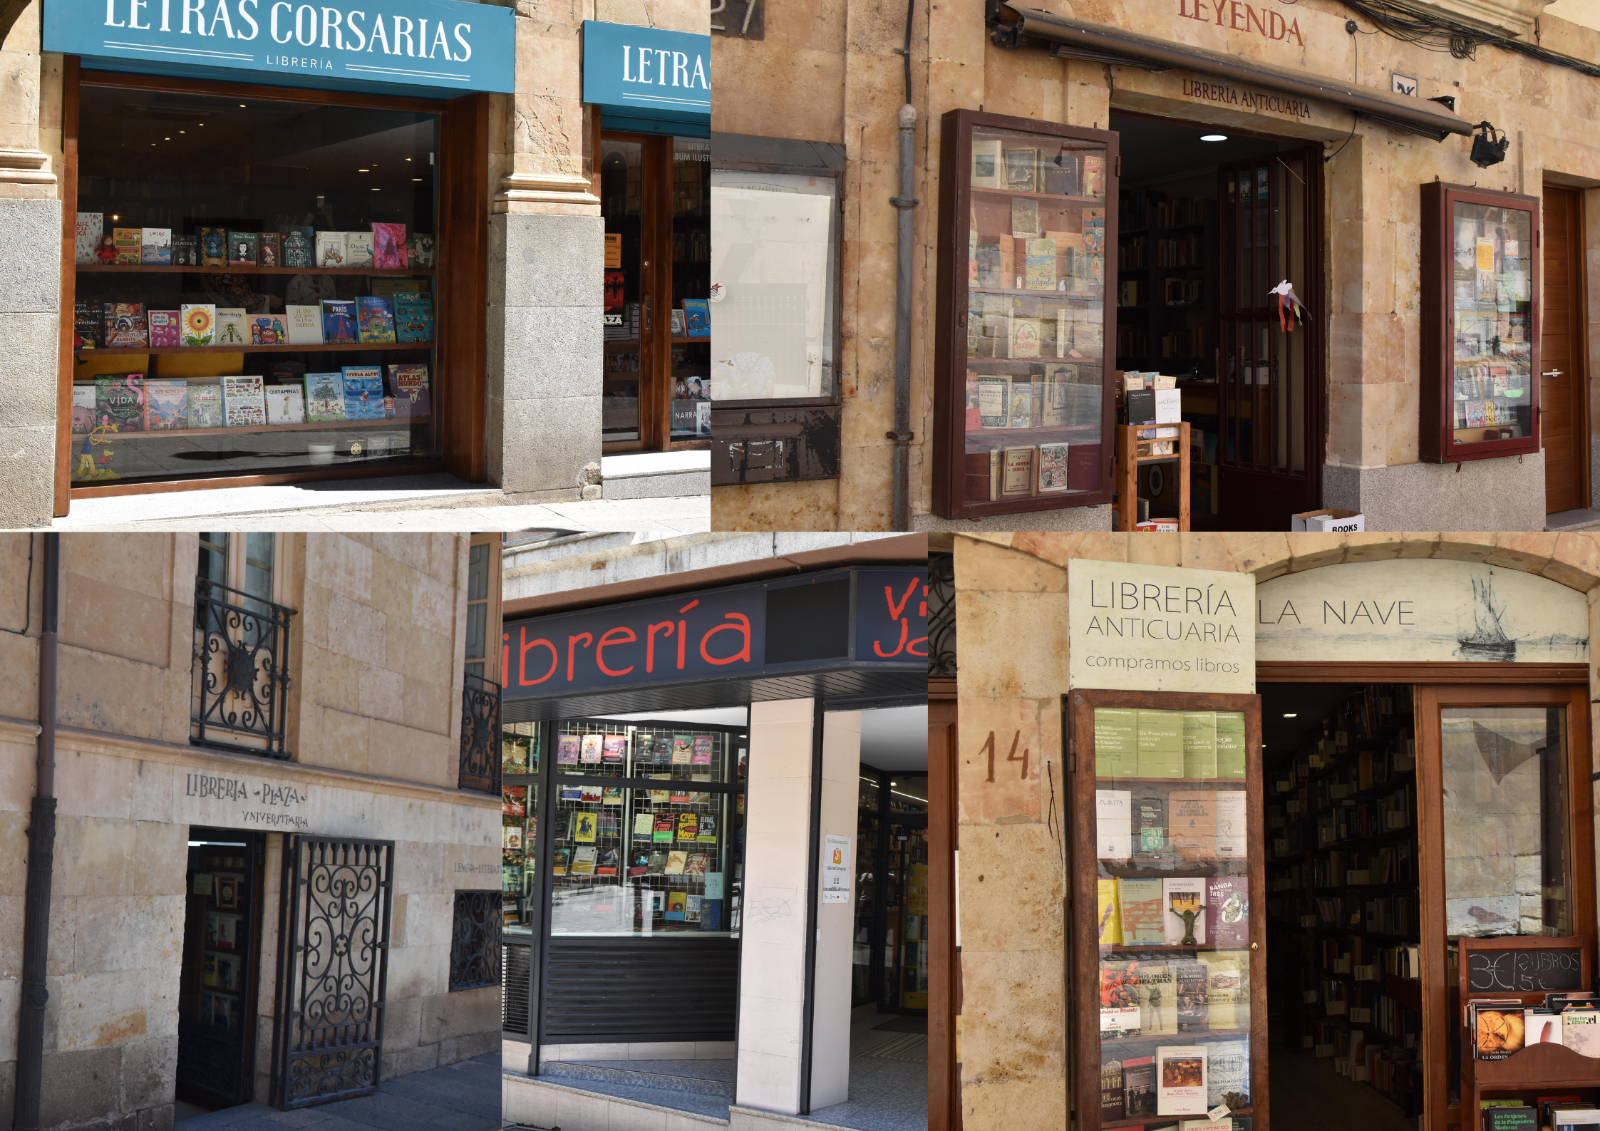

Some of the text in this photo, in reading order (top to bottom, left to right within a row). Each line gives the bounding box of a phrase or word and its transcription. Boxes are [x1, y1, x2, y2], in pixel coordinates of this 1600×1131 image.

[104, 0, 472, 62] LETRAS CORSARIAS
[1178, 0, 1304, 47] LEYENDA
[266, 54, 333, 70] LIBRERÍA
[623, 45, 711, 90] LETRA
[1183, 78, 1311, 119] LIBRERÍA ANTICUARIA
[673, 154, 691, 162] BUM
[109, 396, 134, 406] VIDA
[675, 412, 697, 420] NARRA
[1333, 524, 1358, 532] BOOKS
[1091, 579, 1237, 617] LIBRERÍA
[1259, 600, 1415, 626] LA NAVE
[1086, 616, 1241, 644] ANTICUARIA
[1086, 655, 1240, 674] compramos libros
[978, 730, 1029, 783] 14
[186, 773, 299, 807] LIBRERIA PLAZA
[1209, 882, 1233, 892] BANDA
[1210, 890, 1225, 898] TRES
